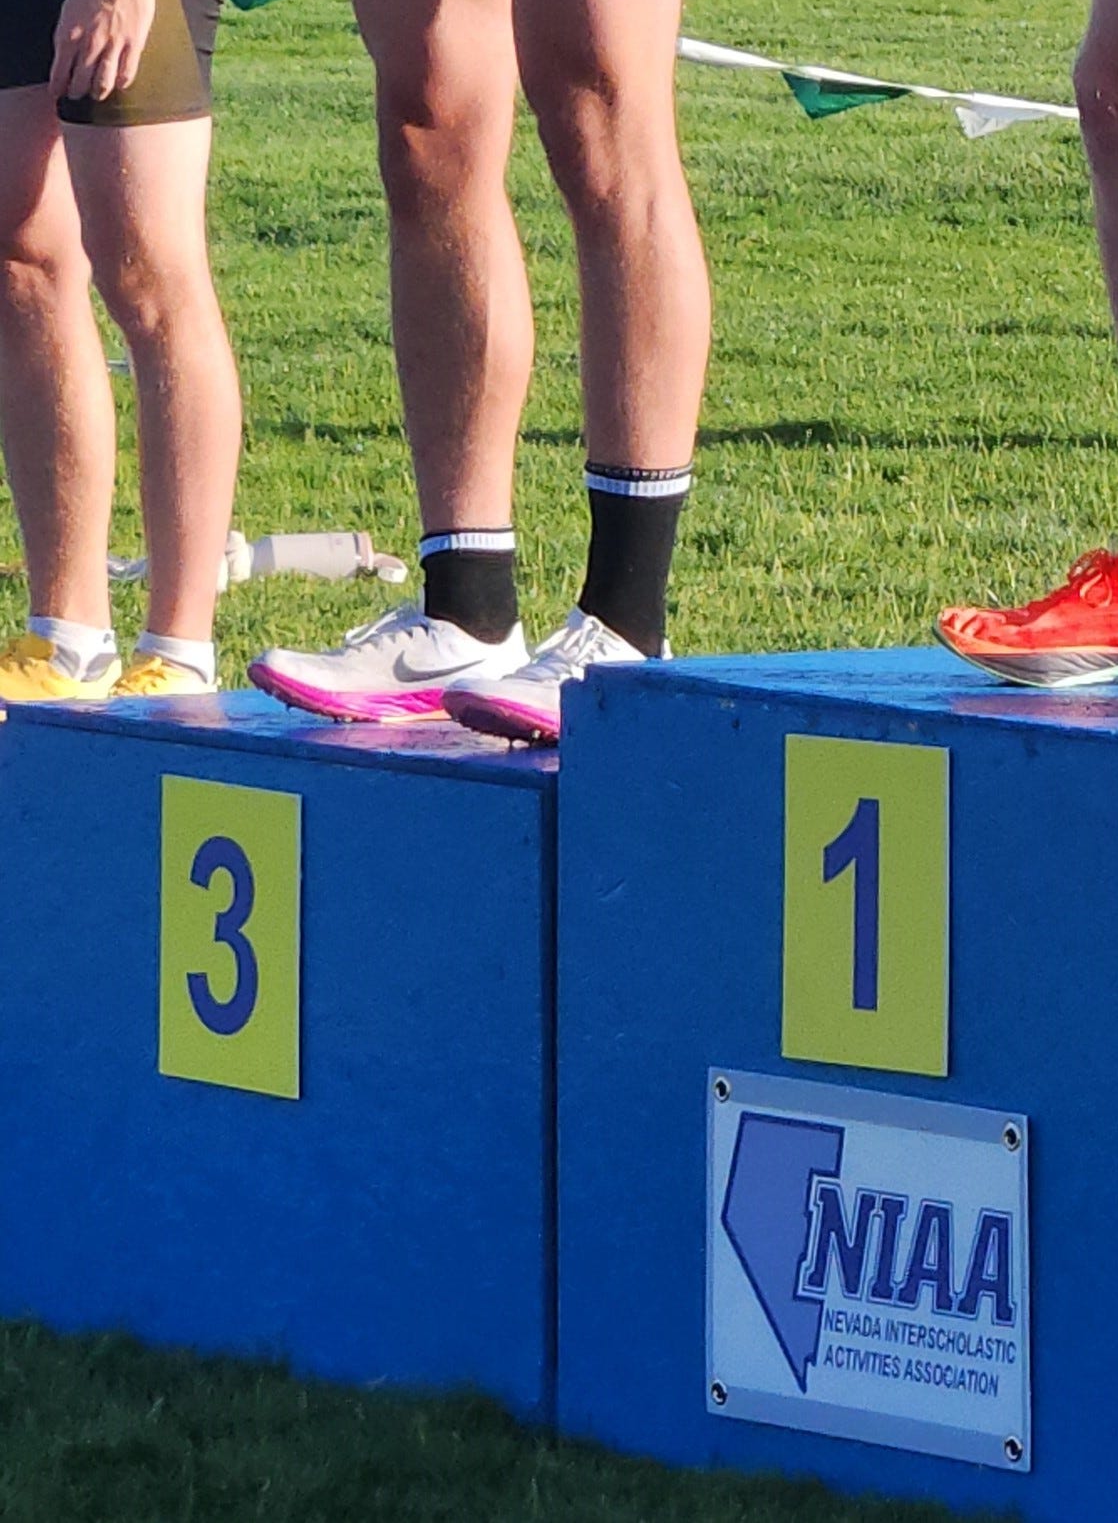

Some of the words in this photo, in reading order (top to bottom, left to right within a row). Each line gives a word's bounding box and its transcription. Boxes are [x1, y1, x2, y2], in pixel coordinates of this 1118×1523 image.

[186, 835, 259, 1036] 3
[823, 797, 880, 1011] 1
[802, 1176, 1017, 1329] NIAA
[824, 1308, 882, 1341] NEVADA
[884, 1320, 1018, 1364] INTERSCHOLASTIC
[824, 1344, 902, 1380] ACTIVITIES
[903, 1359, 1000, 1398] ASSOCIATION
